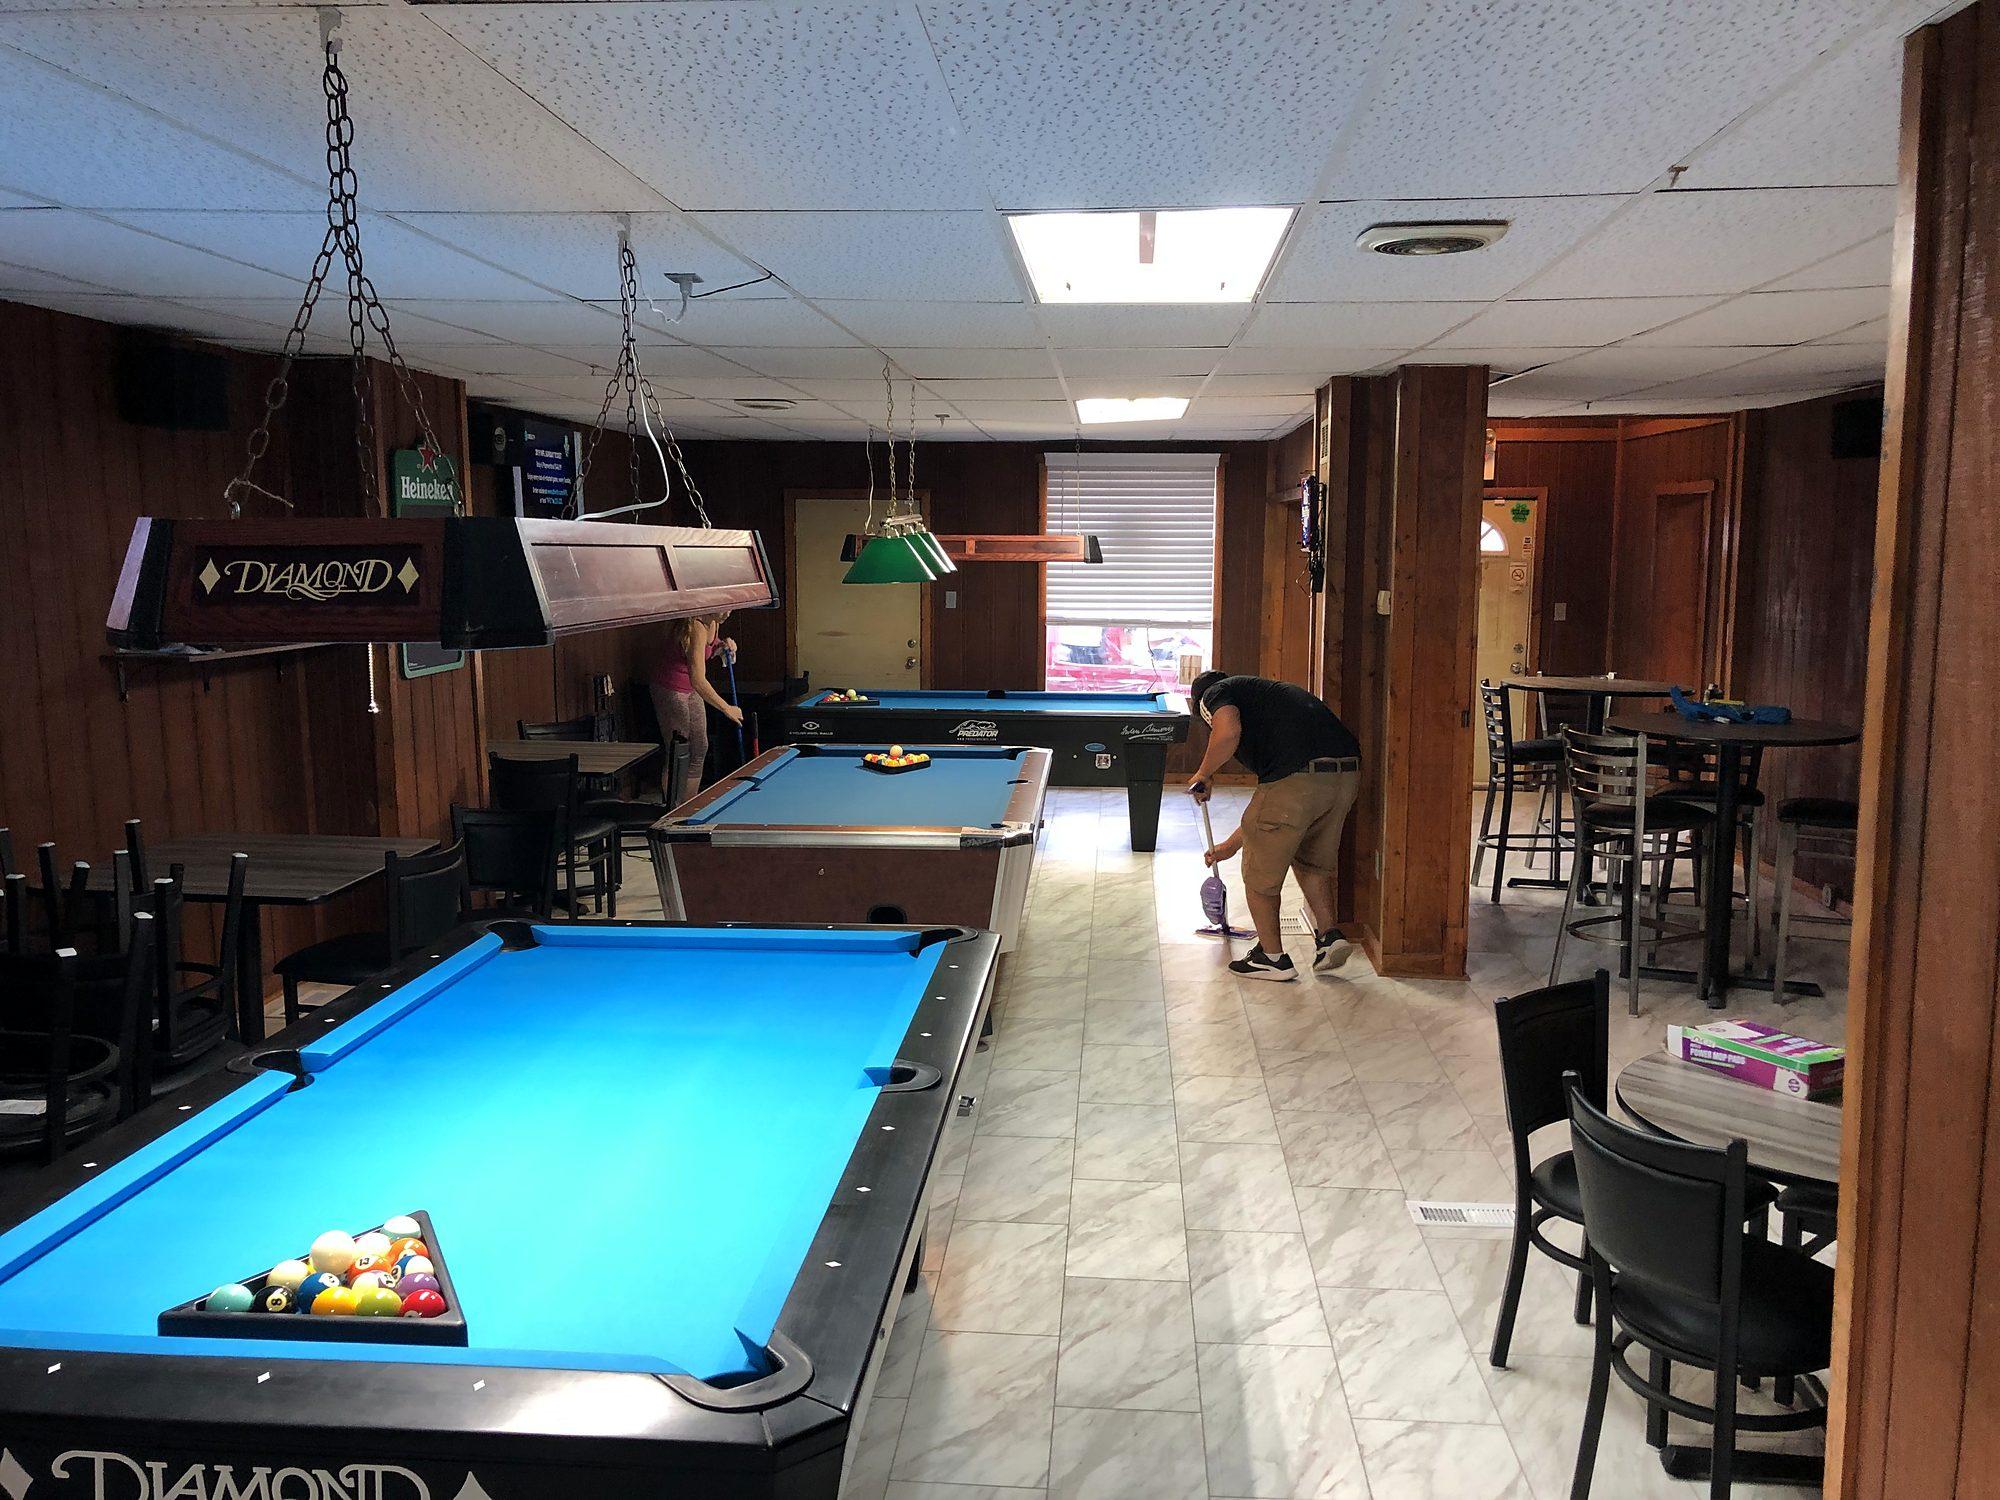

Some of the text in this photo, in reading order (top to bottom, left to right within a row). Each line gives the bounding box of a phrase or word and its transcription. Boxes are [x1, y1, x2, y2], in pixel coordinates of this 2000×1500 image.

[224, 559, 393, 601] DIAMOND
[957, 730, 999, 738] PREDATOR
[1690, 1048, 1712, 1059] POWER
[359, 1257, 370, 1266] 13
[270, 1298, 283, 1306] 8
[51, 1449, 431, 1500] DIAMOND
